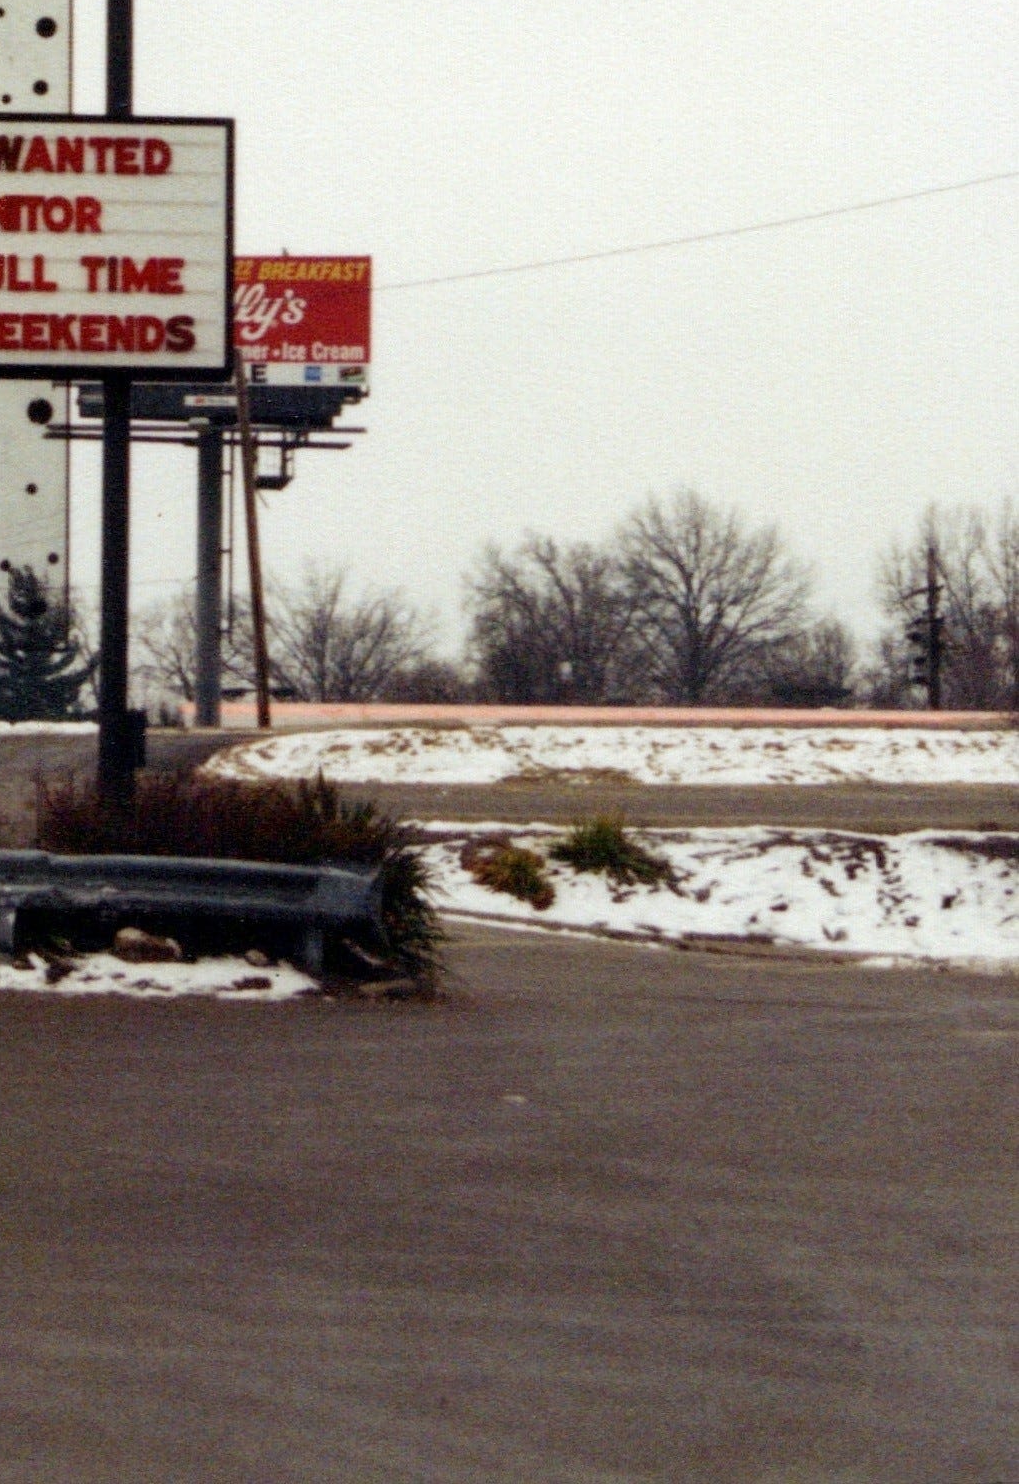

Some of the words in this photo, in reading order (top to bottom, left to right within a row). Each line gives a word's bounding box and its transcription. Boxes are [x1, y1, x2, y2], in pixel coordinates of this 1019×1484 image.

[79, 256, 186, 295] TIME
[257, 261, 368, 281] BREAKFAST
[312, 341, 365, 361] Cream
